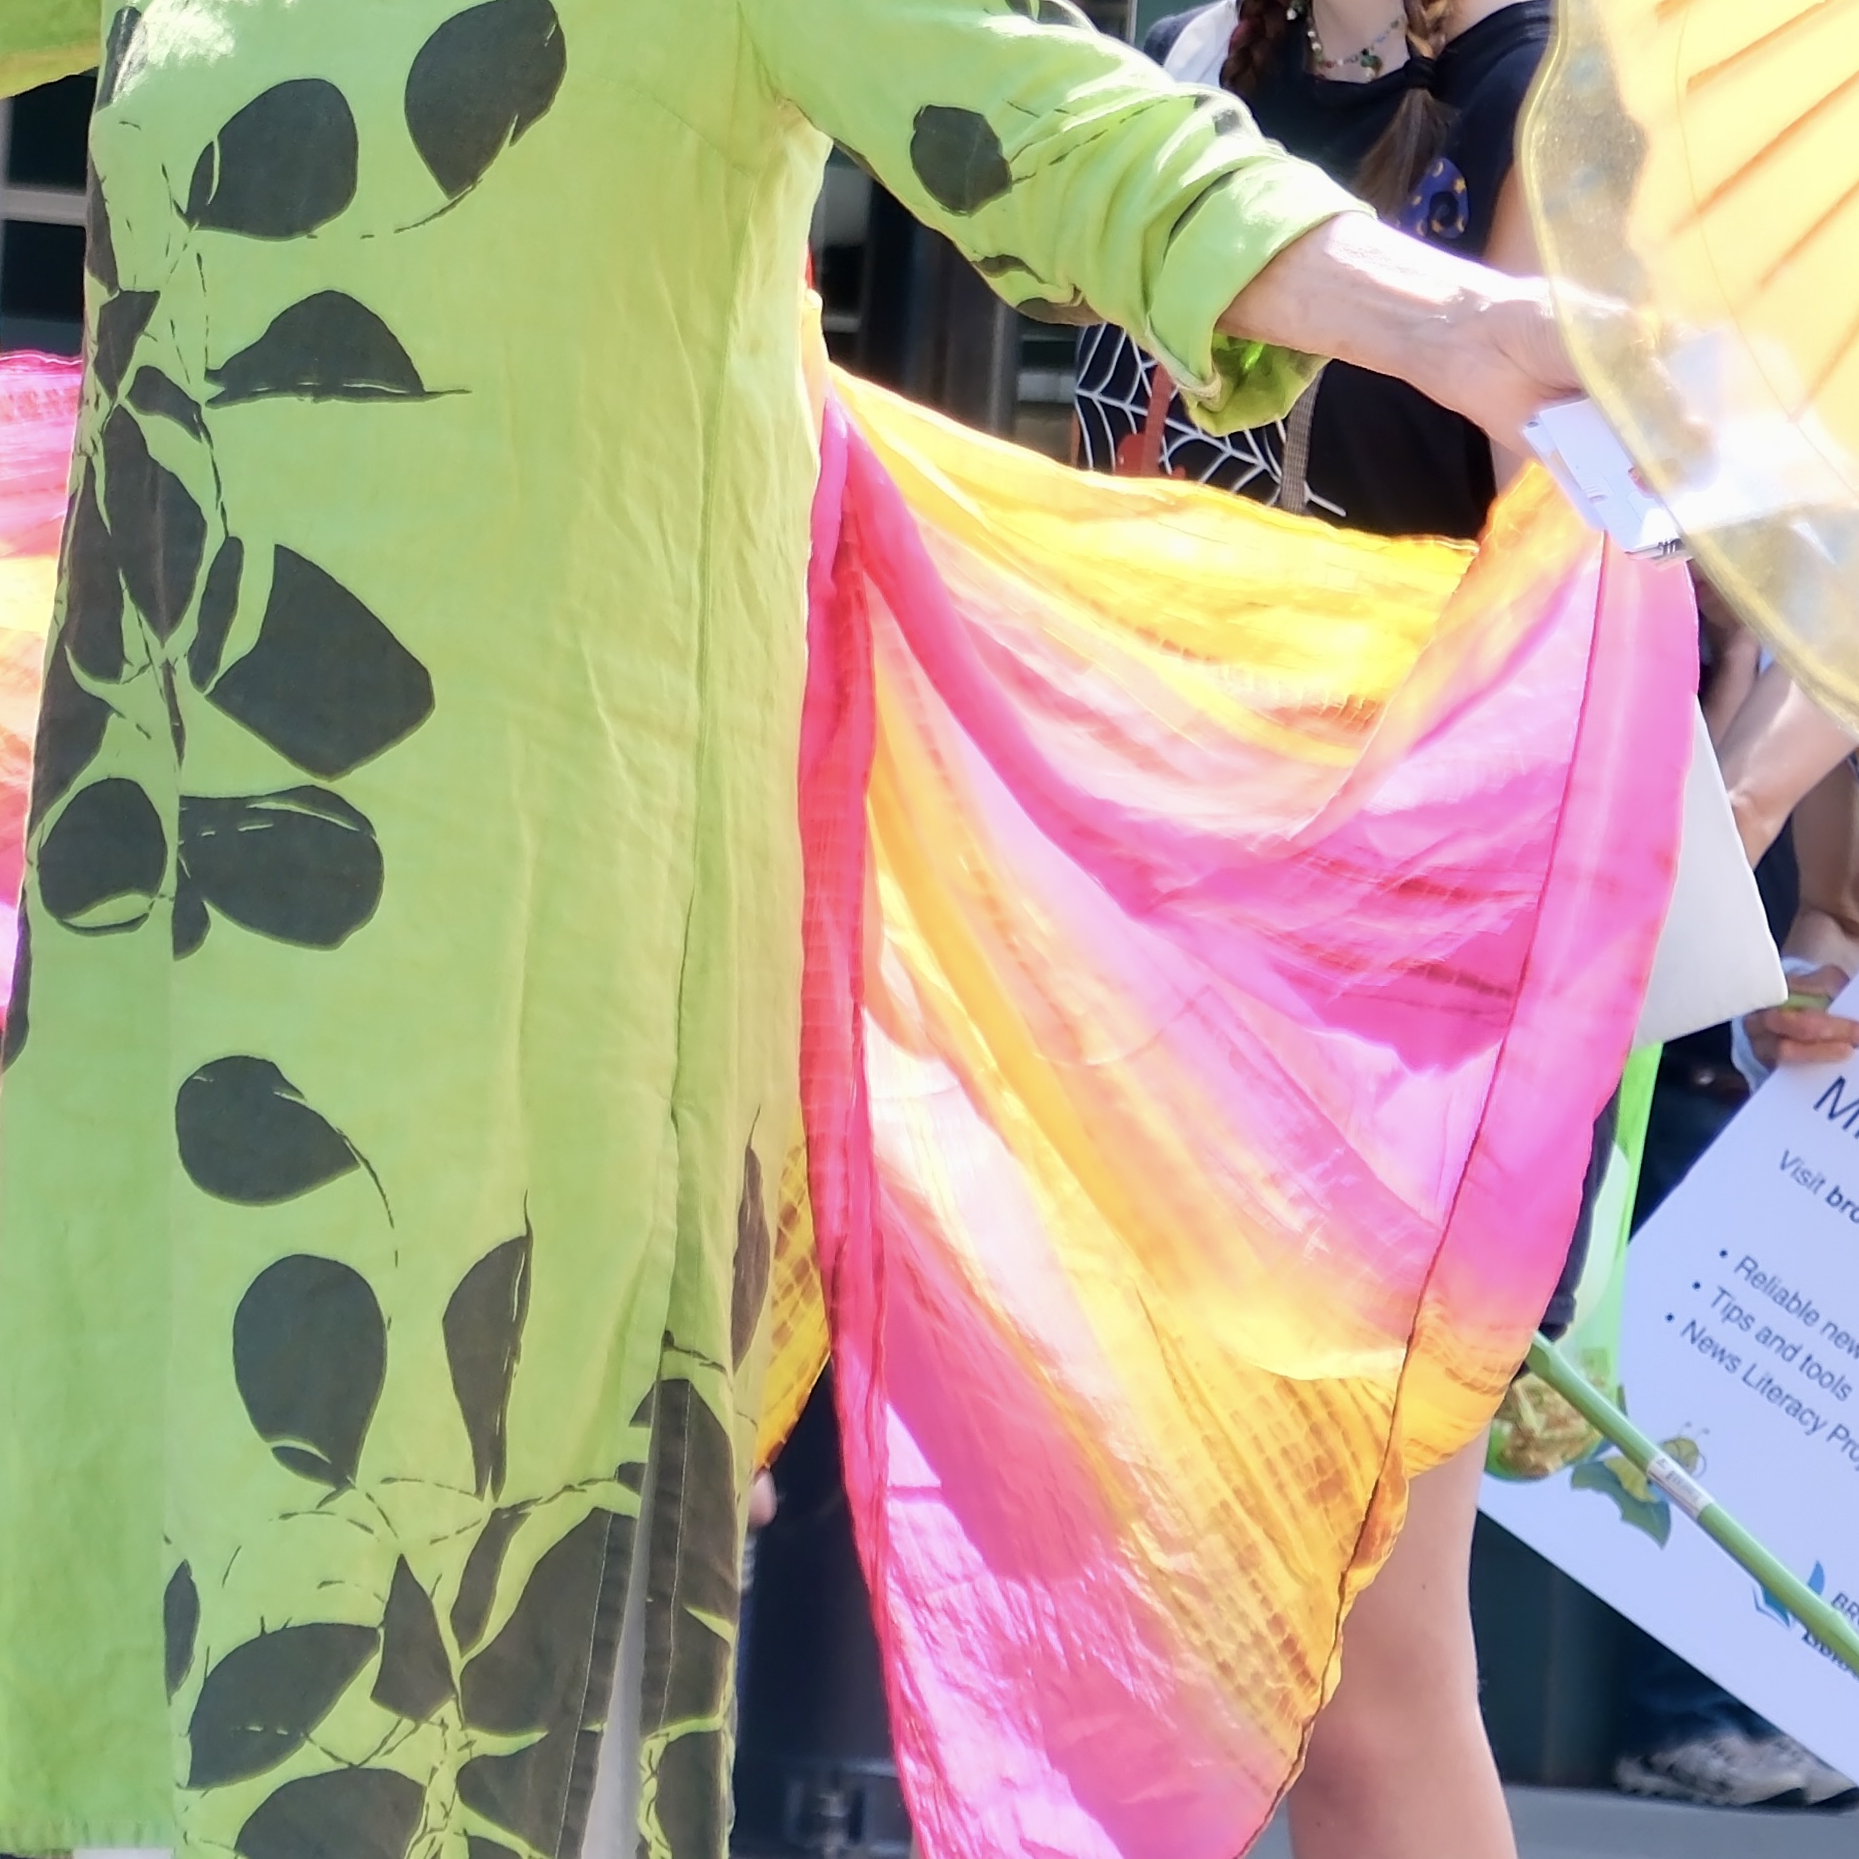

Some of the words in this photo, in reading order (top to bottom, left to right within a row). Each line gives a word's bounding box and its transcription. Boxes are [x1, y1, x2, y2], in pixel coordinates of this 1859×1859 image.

[1780, 1149, 1826, 1195] Visit
[1733, 1254, 1820, 1327] Reliable
[1680, 1318, 1742, 1374] News
[1741, 1362, 1828, 1436] Literacy
[1710, 1285, 1756, 1332] Tips
[1754, 1325, 1803, 1362] and
[1798, 1353, 1853, 1402] tools
